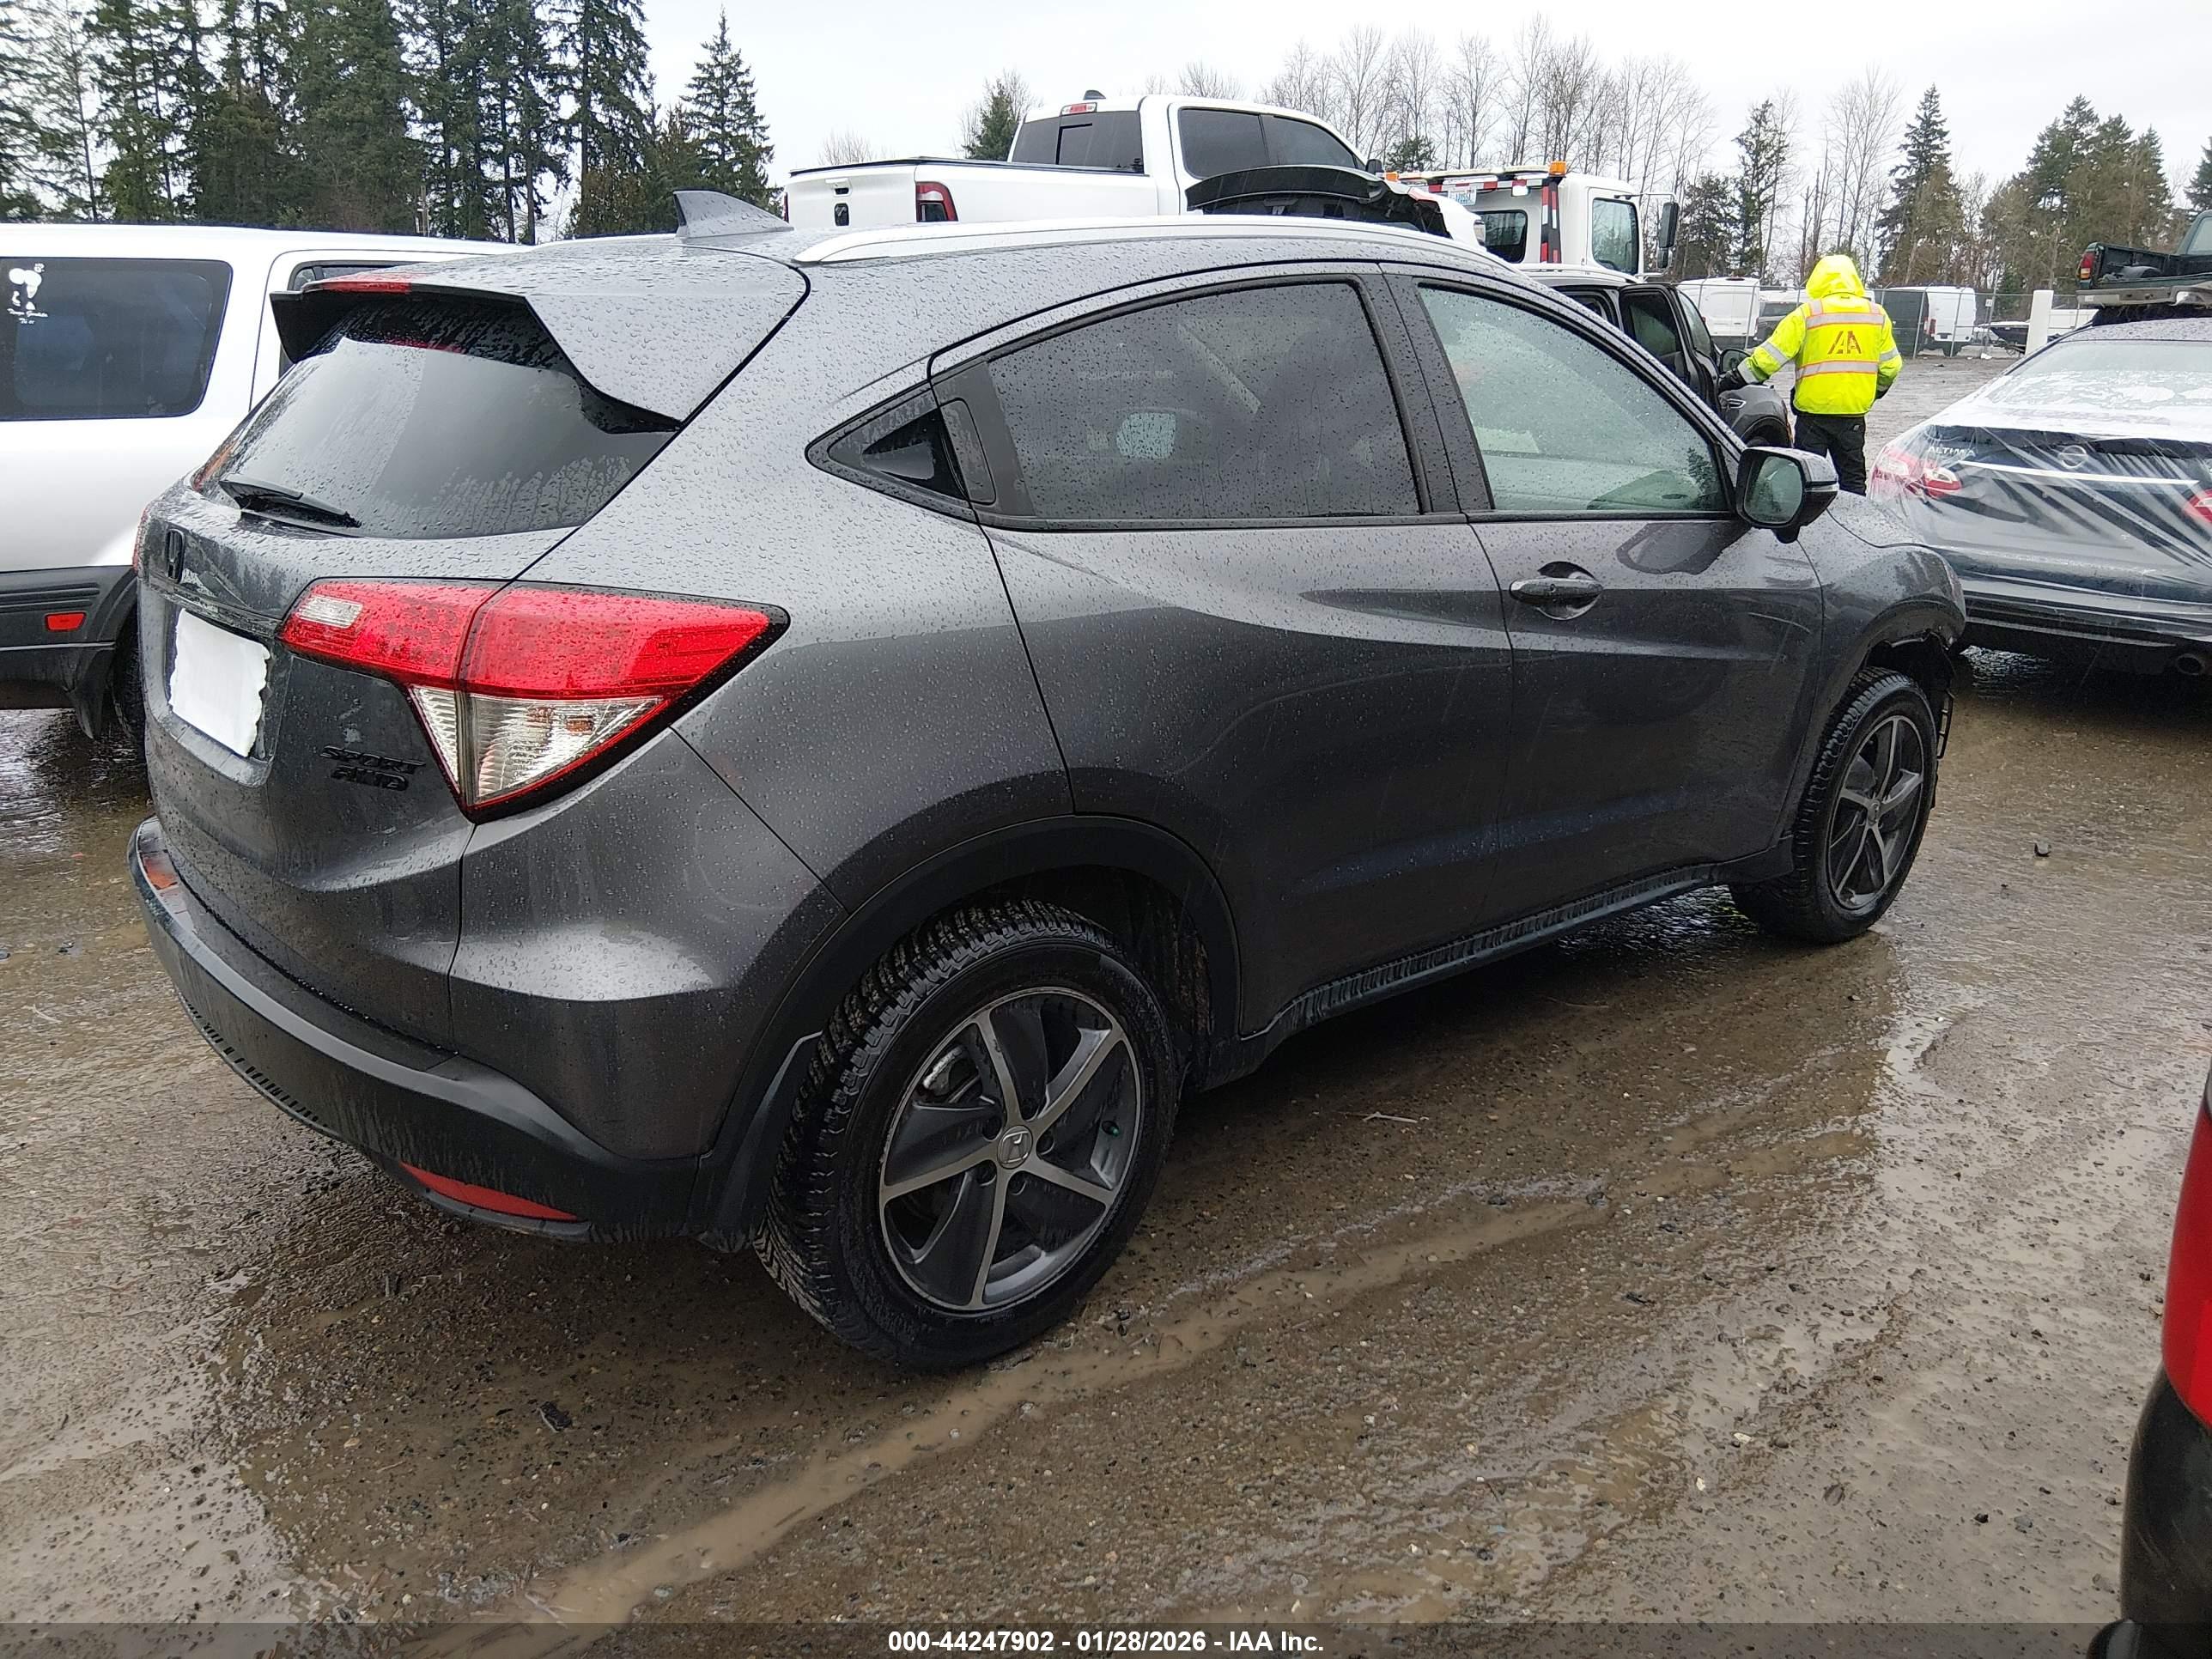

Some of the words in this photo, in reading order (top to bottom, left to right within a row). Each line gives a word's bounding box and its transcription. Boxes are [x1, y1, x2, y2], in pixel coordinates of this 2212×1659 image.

[1926, 445, 1976, 458] ALTIMA
[319, 744, 427, 775] SPORT
[331, 764, 410, 792] AWD
